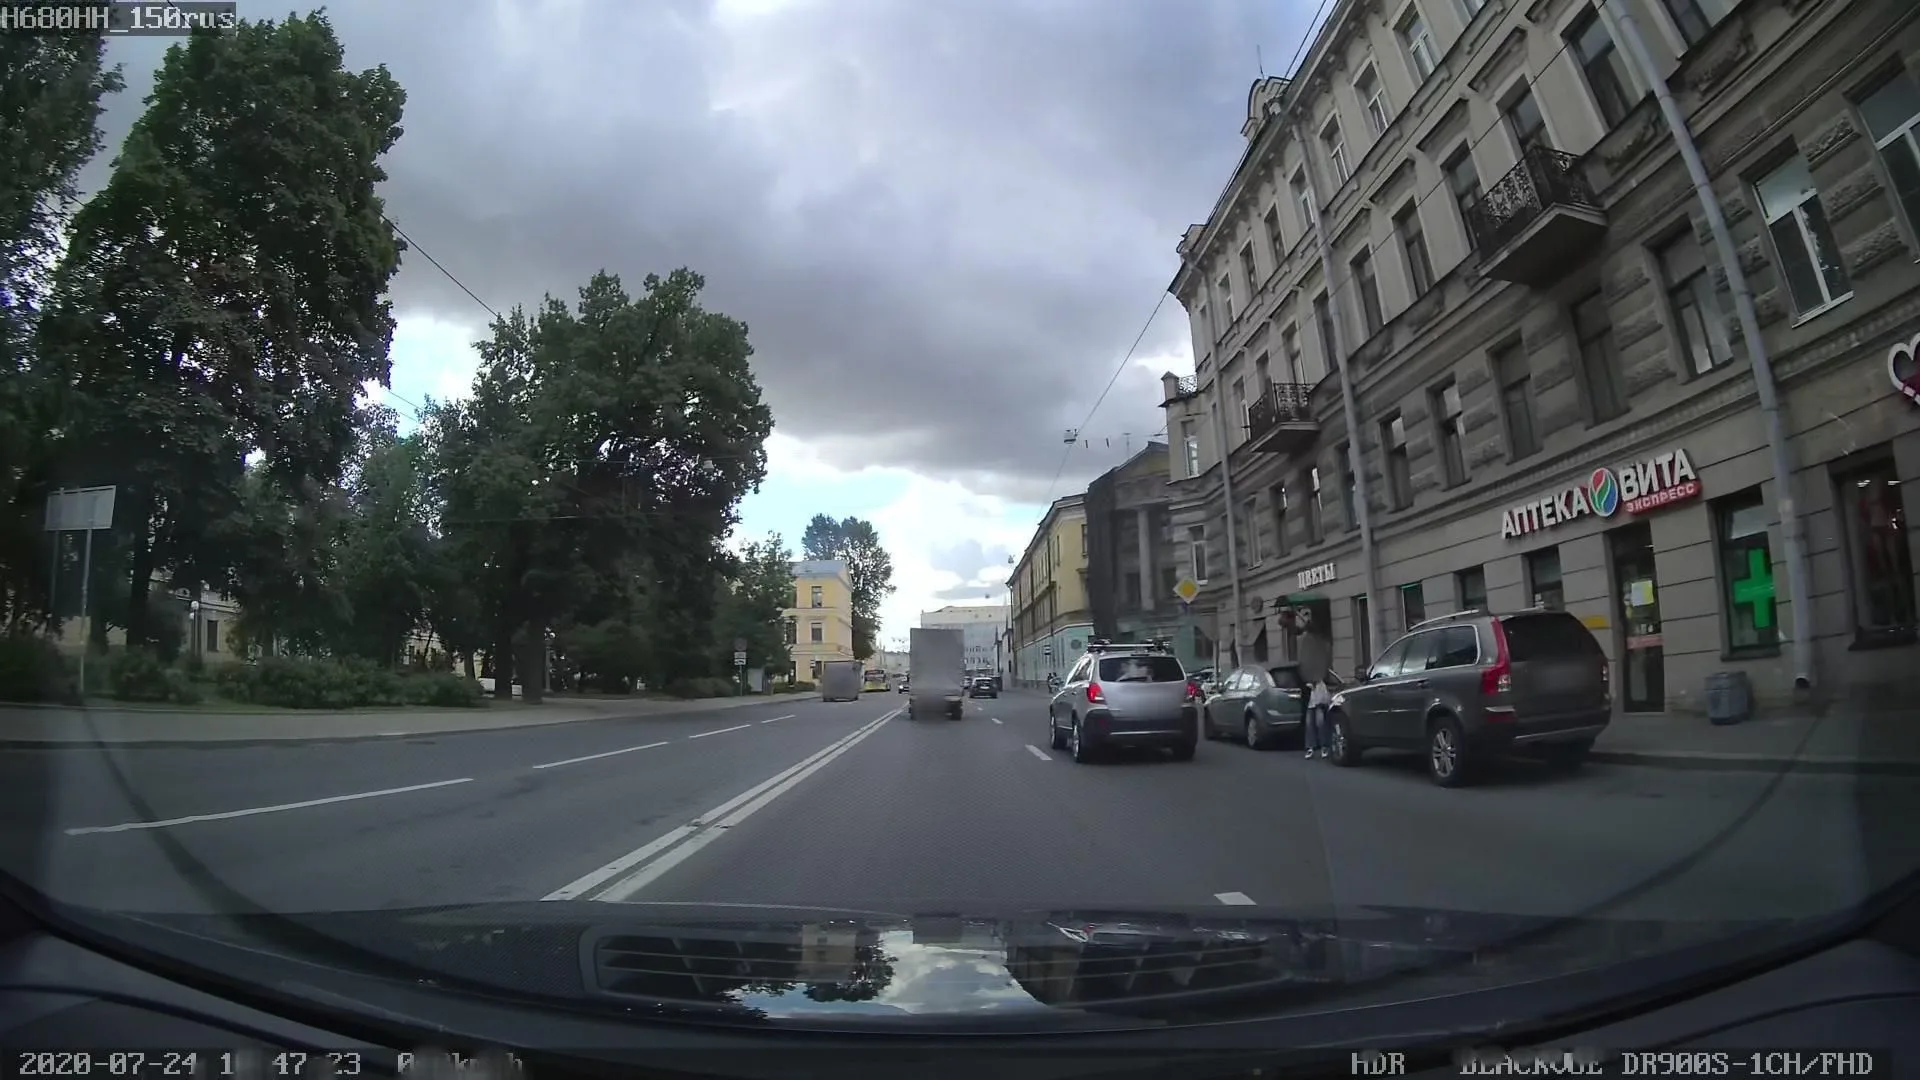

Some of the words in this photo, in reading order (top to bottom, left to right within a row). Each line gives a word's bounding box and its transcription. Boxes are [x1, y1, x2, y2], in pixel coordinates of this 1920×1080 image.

[1502, 487, 1590, 540] АПТЕКА
[1618, 449, 1696, 502] ВИТА
[1626, 483, 1695, 513] ЭКСПРЕСС
[1298, 562, 1336, 590] ЦВЕТЫ
